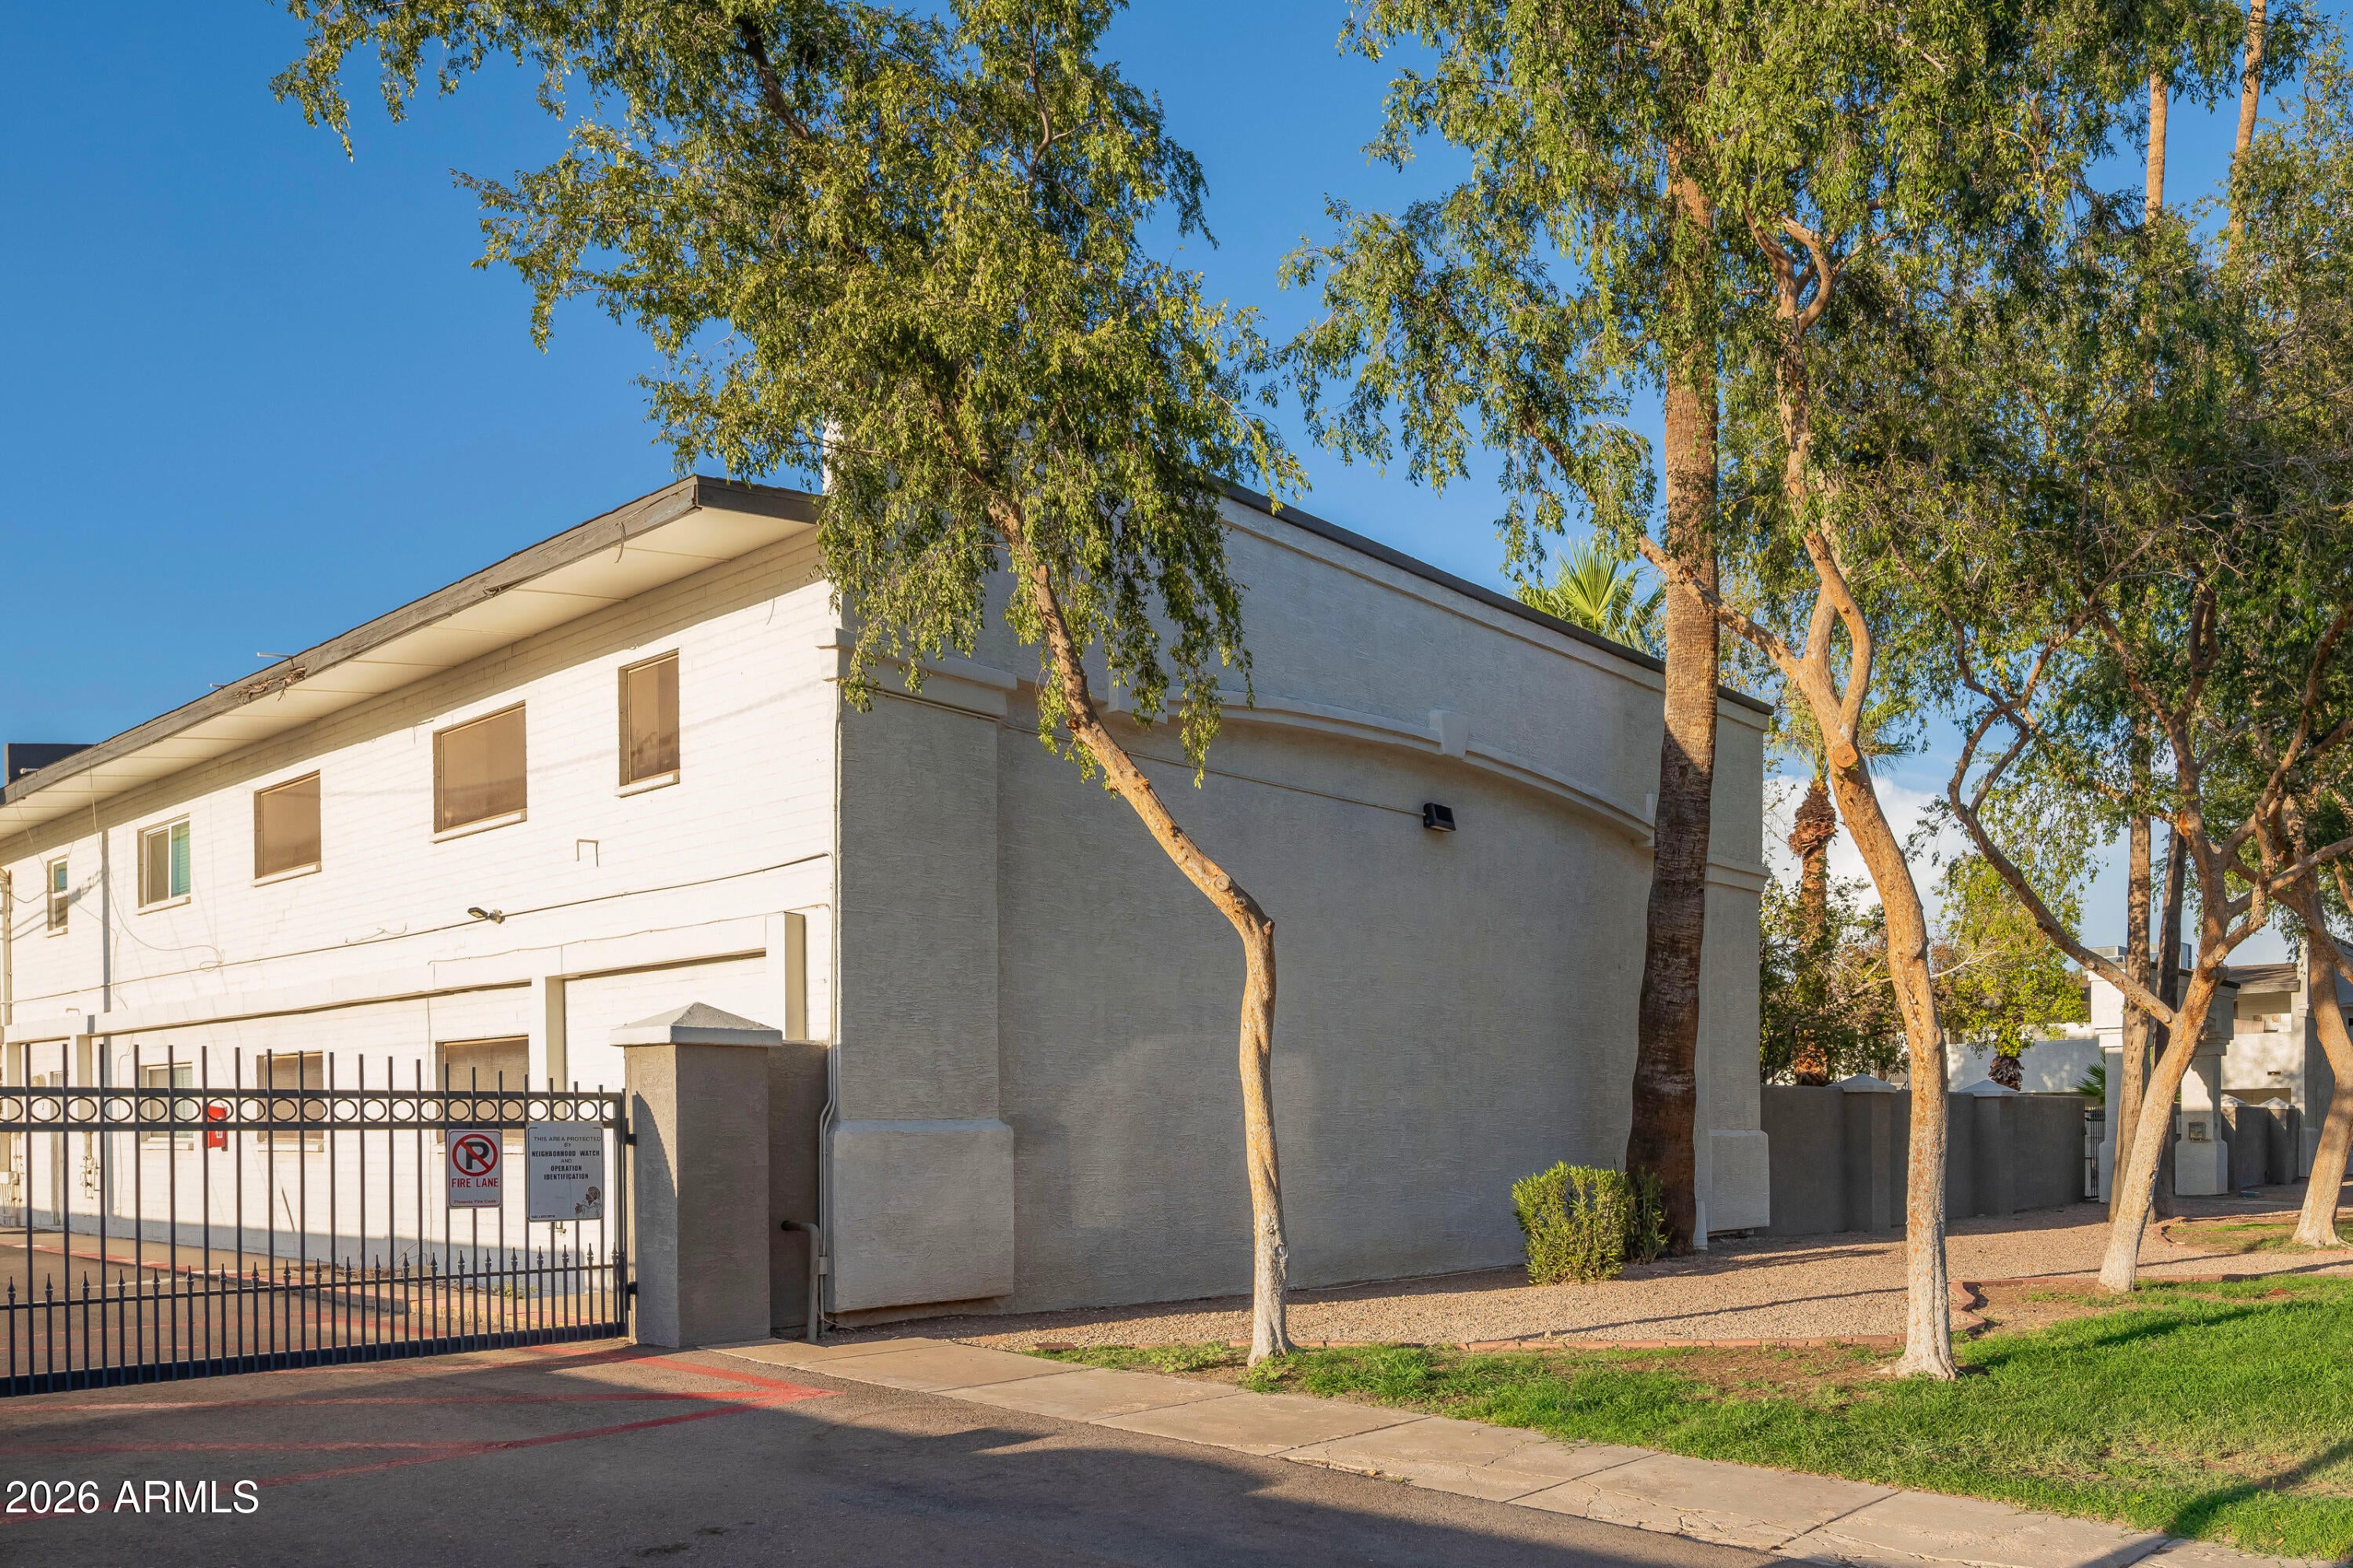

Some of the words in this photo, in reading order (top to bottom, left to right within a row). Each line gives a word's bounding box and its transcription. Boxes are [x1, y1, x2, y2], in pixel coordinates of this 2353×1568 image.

[465, 1141, 489, 1170] P
[452, 1178, 471, 1188] FIRE
[476, 1177, 499, 1188] LANE
